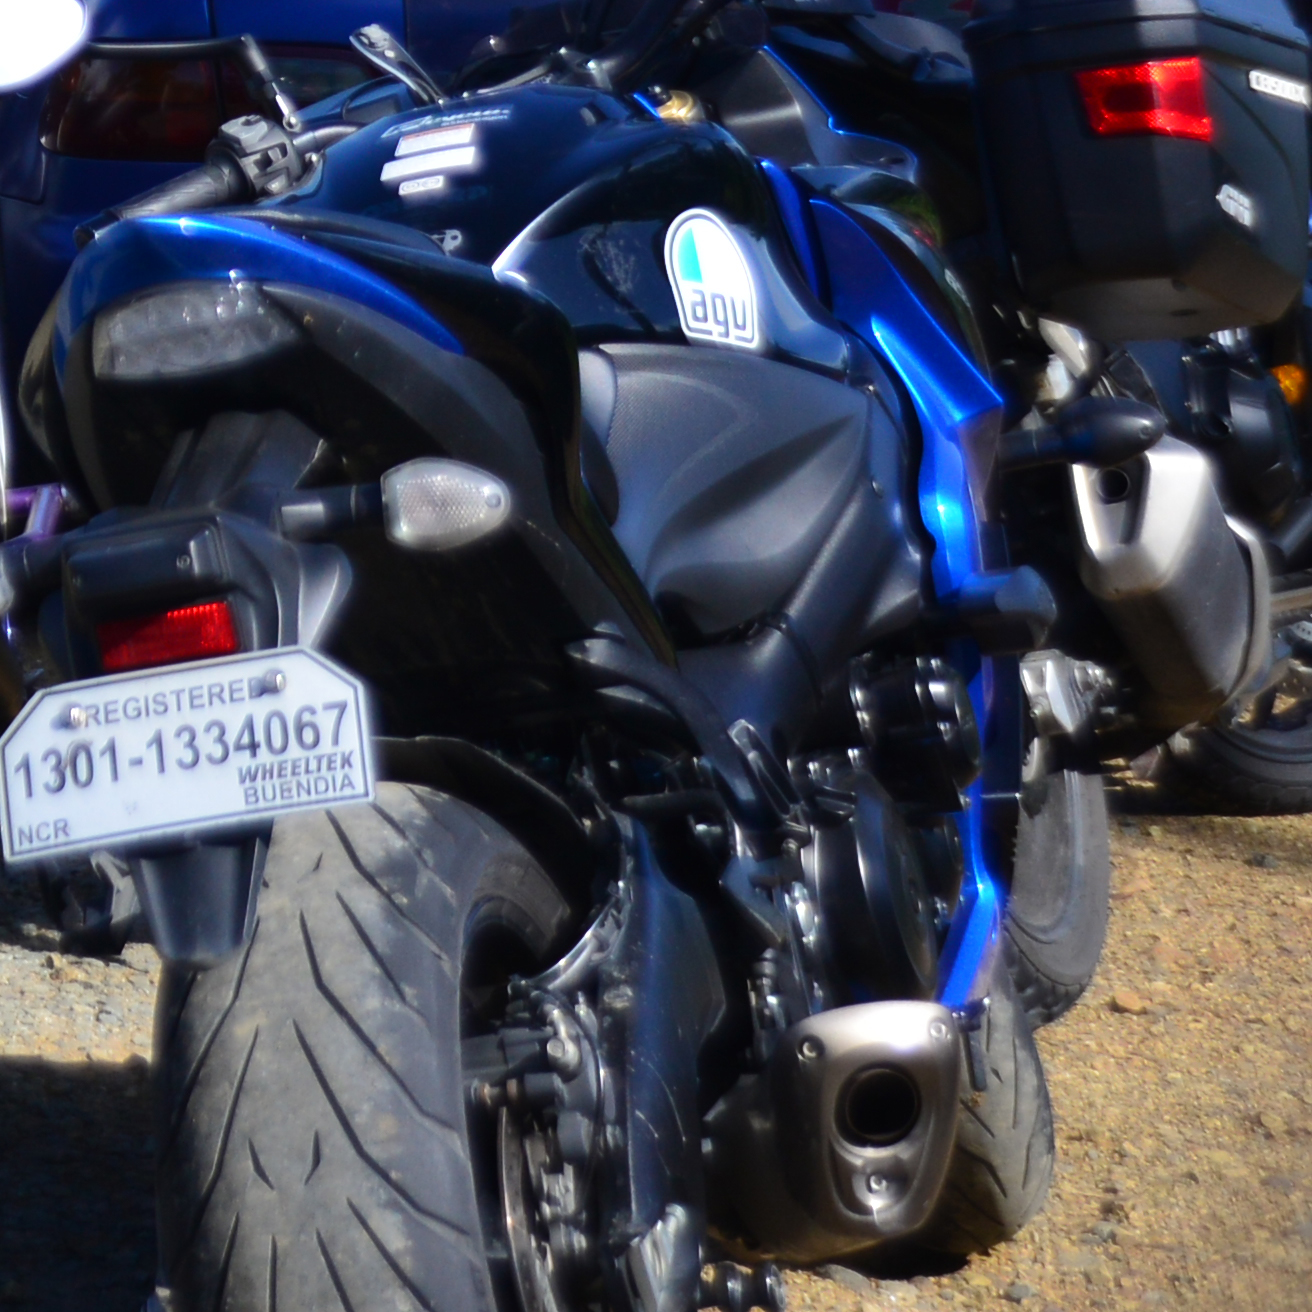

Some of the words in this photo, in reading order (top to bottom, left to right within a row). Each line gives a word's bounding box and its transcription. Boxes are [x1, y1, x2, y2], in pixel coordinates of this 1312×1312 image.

[14, 699, 349, 799] 1301-1334067
[237, 749, 355, 786] WHEELTEK
[243, 771, 356, 807] BUENDIA
[17, 818, 71, 847] NCR
